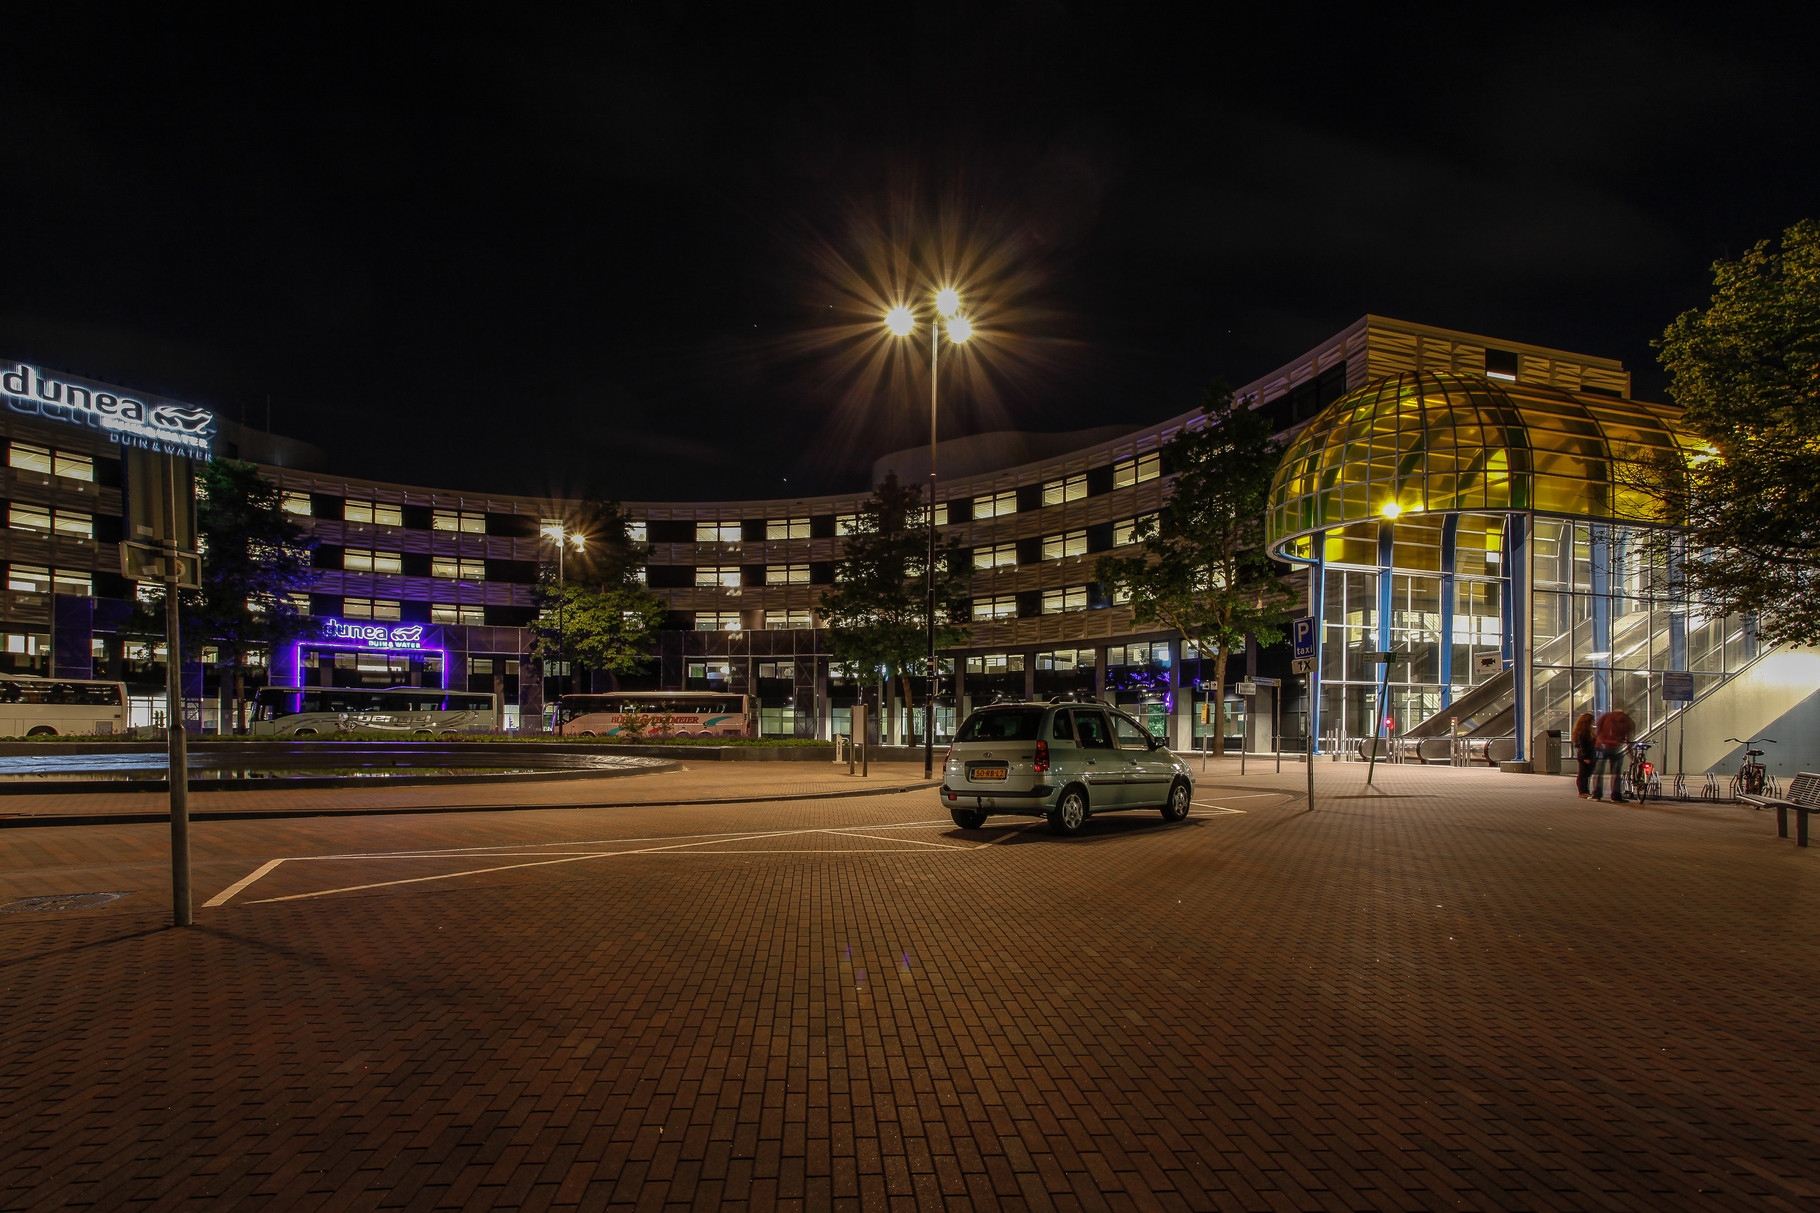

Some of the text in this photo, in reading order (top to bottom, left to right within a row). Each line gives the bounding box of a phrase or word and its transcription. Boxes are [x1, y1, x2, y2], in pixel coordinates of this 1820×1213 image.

[1, 363, 145, 423] dunea
[110, 432, 148, 449] DUIN
[164, 445, 213, 462] WATER
[322, 618, 389, 642] dunea
[1298, 622, 1310, 643] P
[395, 642, 421, 650] WATER
[1296, 645, 1313, 655] taxi
